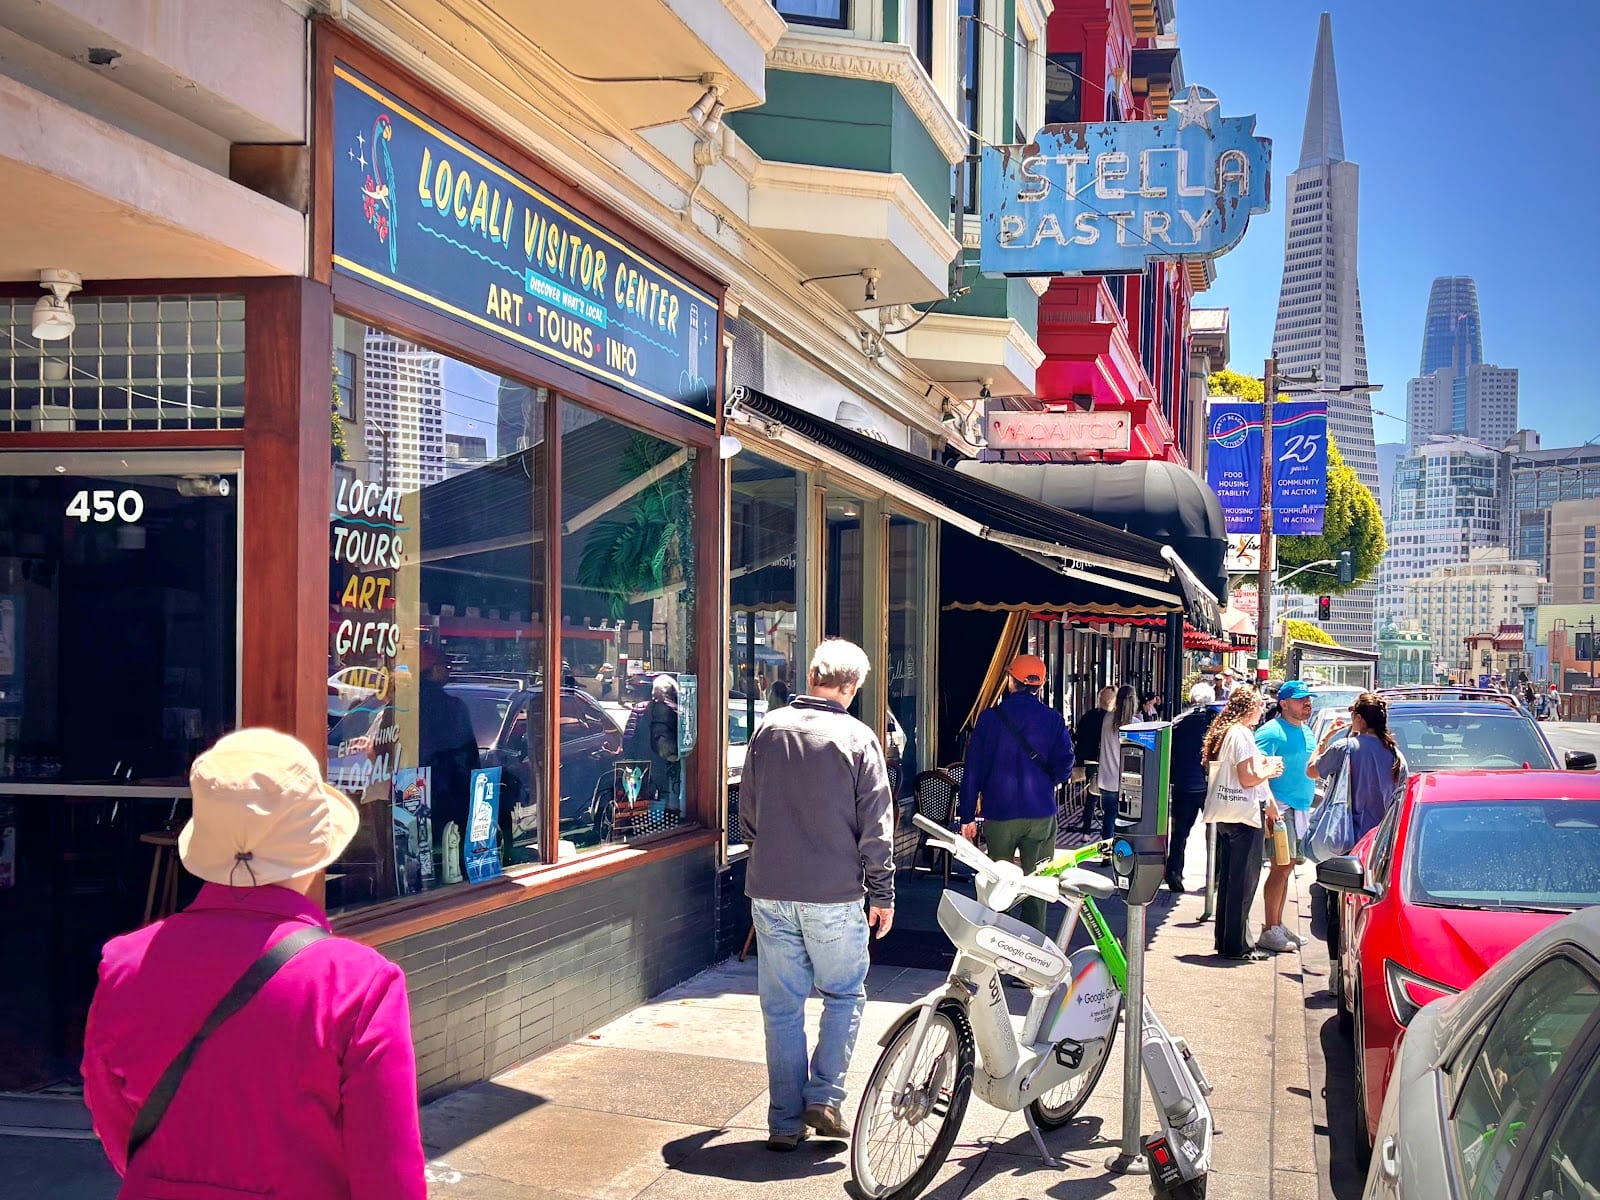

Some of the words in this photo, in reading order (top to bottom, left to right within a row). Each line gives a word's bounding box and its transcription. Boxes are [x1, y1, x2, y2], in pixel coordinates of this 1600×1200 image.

[1017, 149, 1249, 202] STELLA
[418, 147, 514, 249] LOCALI
[523, 208, 607, 300] VISITOR
[614, 262, 680, 338] CENTER
[998, 207, 1216, 249] PASTRY
[529, 275, 560, 302] DISCOVER
[561, 292, 584, 315] WHAT'S
[585, 309, 603, 323] LOCAL
[486, 283, 523, 327] ART
[536, 305, 593, 359] TOURS
[606, 337, 637, 377] INFO
[995, 421, 1121, 440] VACANCY
[1278, 434, 1321, 463] 25
[1216, 490, 1251, 498] STABILITY
[1218, 480, 1249, 488] HOUSING
[1277, 478, 1320, 487] COMMUNITY
[1291, 488, 1318, 496] ACTION
[65, 489, 145, 523] 450
[336, 478, 404, 522] LOCAL
[334, 526, 404, 570] TOURS
[341, 574, 391, 610] ART
[335, 618, 400, 659] GIFTS
[337, 724, 401, 758] EVETHING
[997, 940, 1025, 958] Google
[1024, 952, 1052, 969] Gemini
[1084, 989, 1105, 1004] Google
